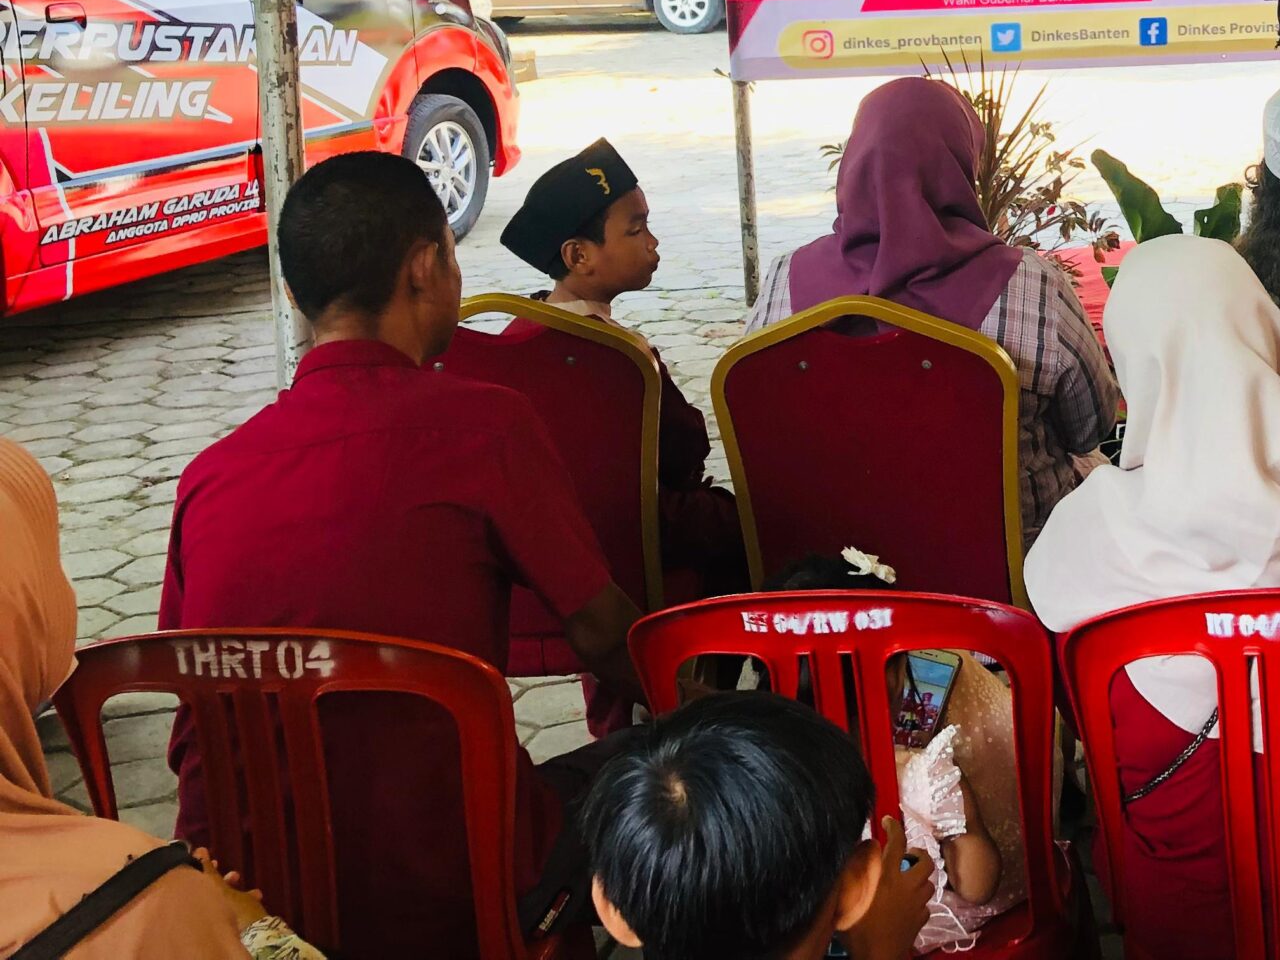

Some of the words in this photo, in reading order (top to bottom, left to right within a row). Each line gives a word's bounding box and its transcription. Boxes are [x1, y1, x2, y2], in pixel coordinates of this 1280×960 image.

[843, 34, 982, 50] dinkes_provbanten
[1031, 28, 1130, 42] DinkesBanten
[1178, 23, 1226, 36] DinKes
[0, 81, 213, 122] KELILING
[40, 200, 160, 245] ABRAHAM
[163, 183, 239, 215] GARUDA
[105, 220, 168, 244] ANGGOTA
[172, 209, 206, 229] DPRD
